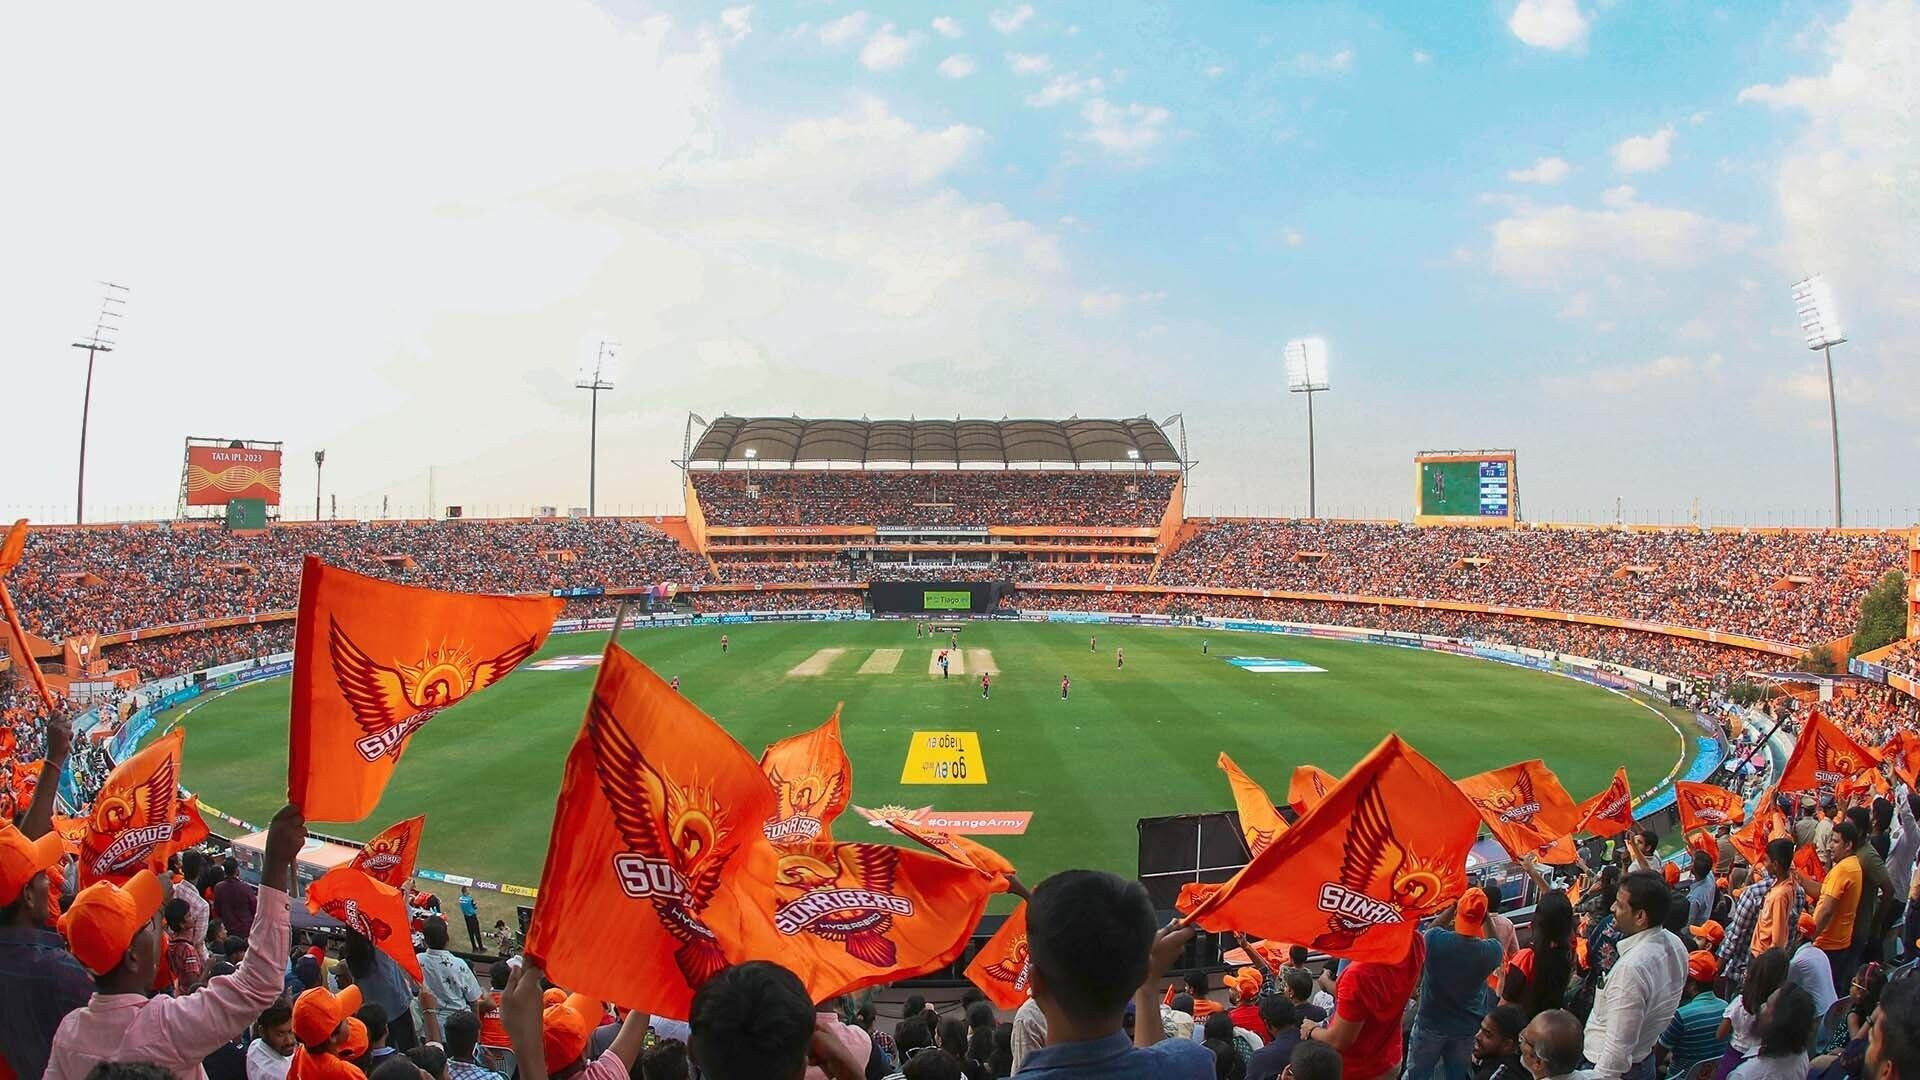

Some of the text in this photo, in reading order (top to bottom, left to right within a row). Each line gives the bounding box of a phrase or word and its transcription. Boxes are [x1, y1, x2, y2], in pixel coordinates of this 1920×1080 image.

[212, 452, 263, 462] TATA IPL 2023
[927, 818, 1024, 828] #OrangeArmy
[476, 881, 498, 890] upstox
[774, 890, 913, 934] SUNRISERS
[819, 911, 882, 931] HYDERABAD
